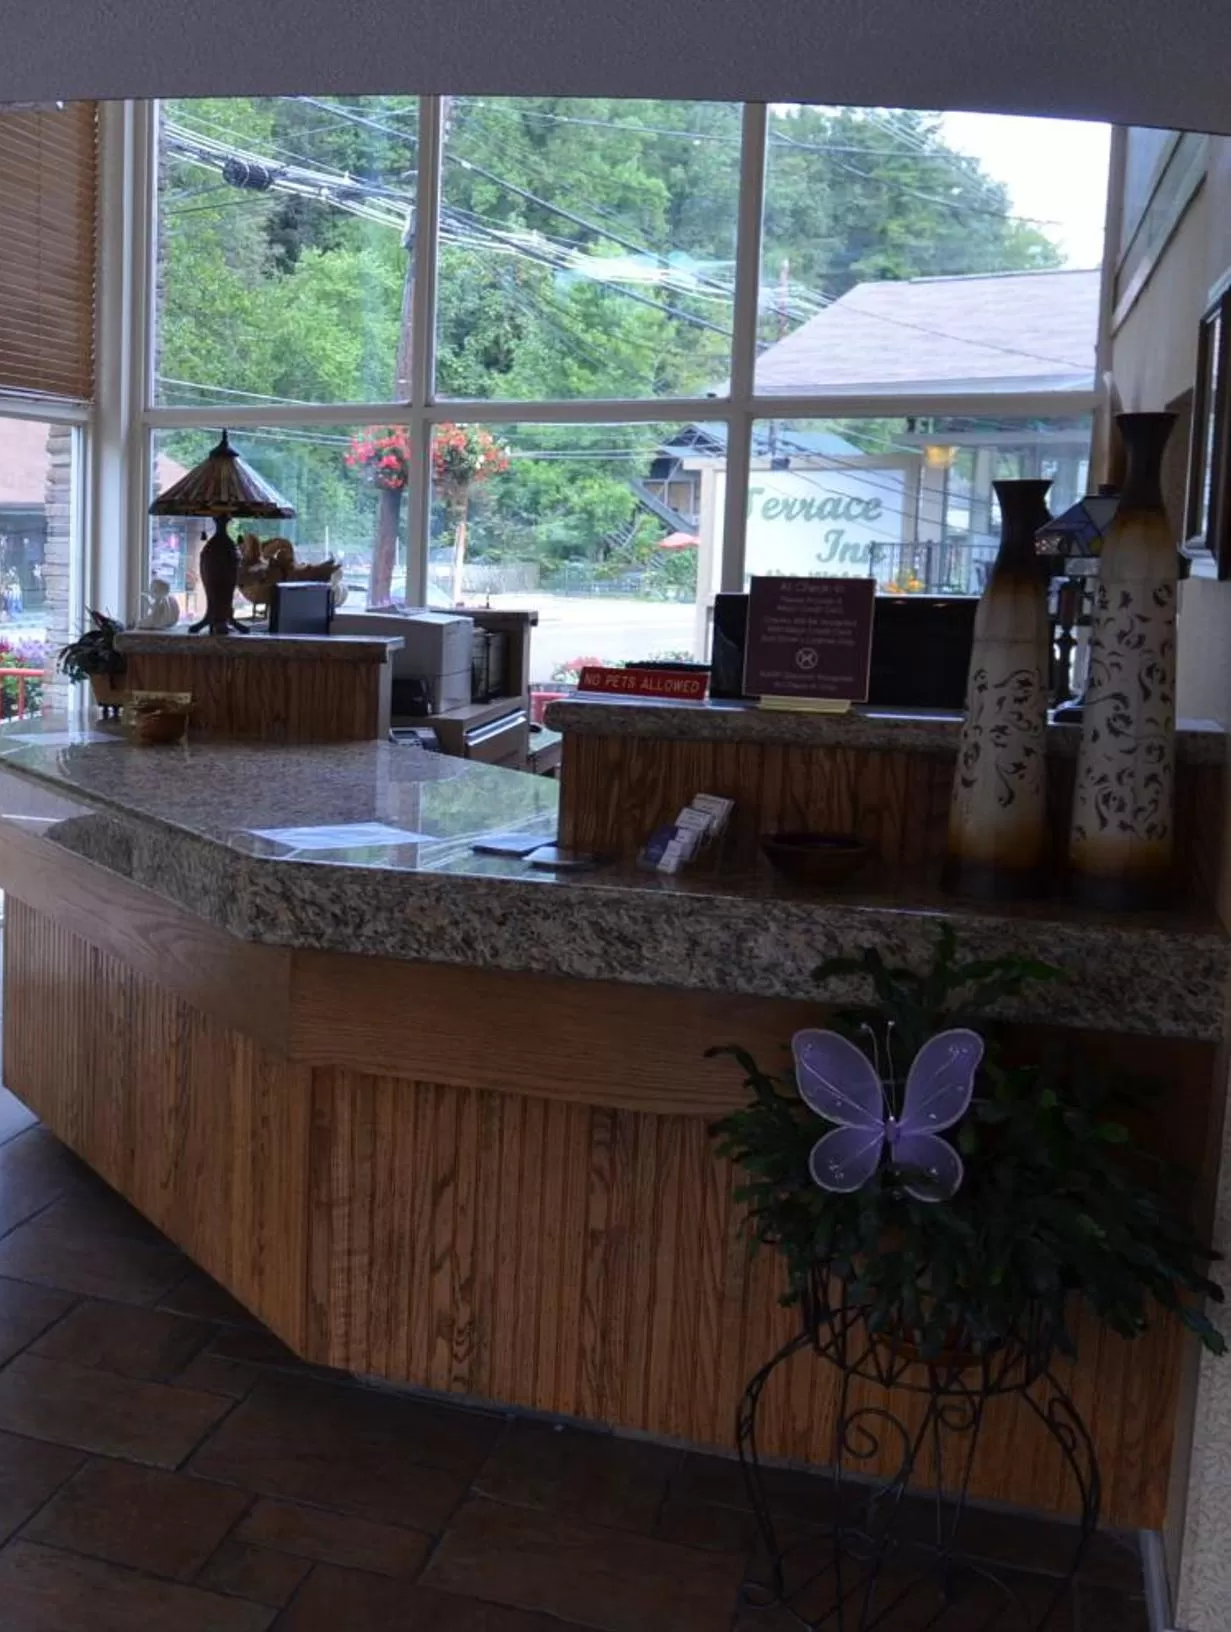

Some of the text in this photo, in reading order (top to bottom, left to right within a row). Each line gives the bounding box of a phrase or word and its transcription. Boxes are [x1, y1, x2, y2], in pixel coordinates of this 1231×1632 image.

[816, 529, 886, 564] Inn
[582, 672, 700, 693] NO PETS ALLOWED
